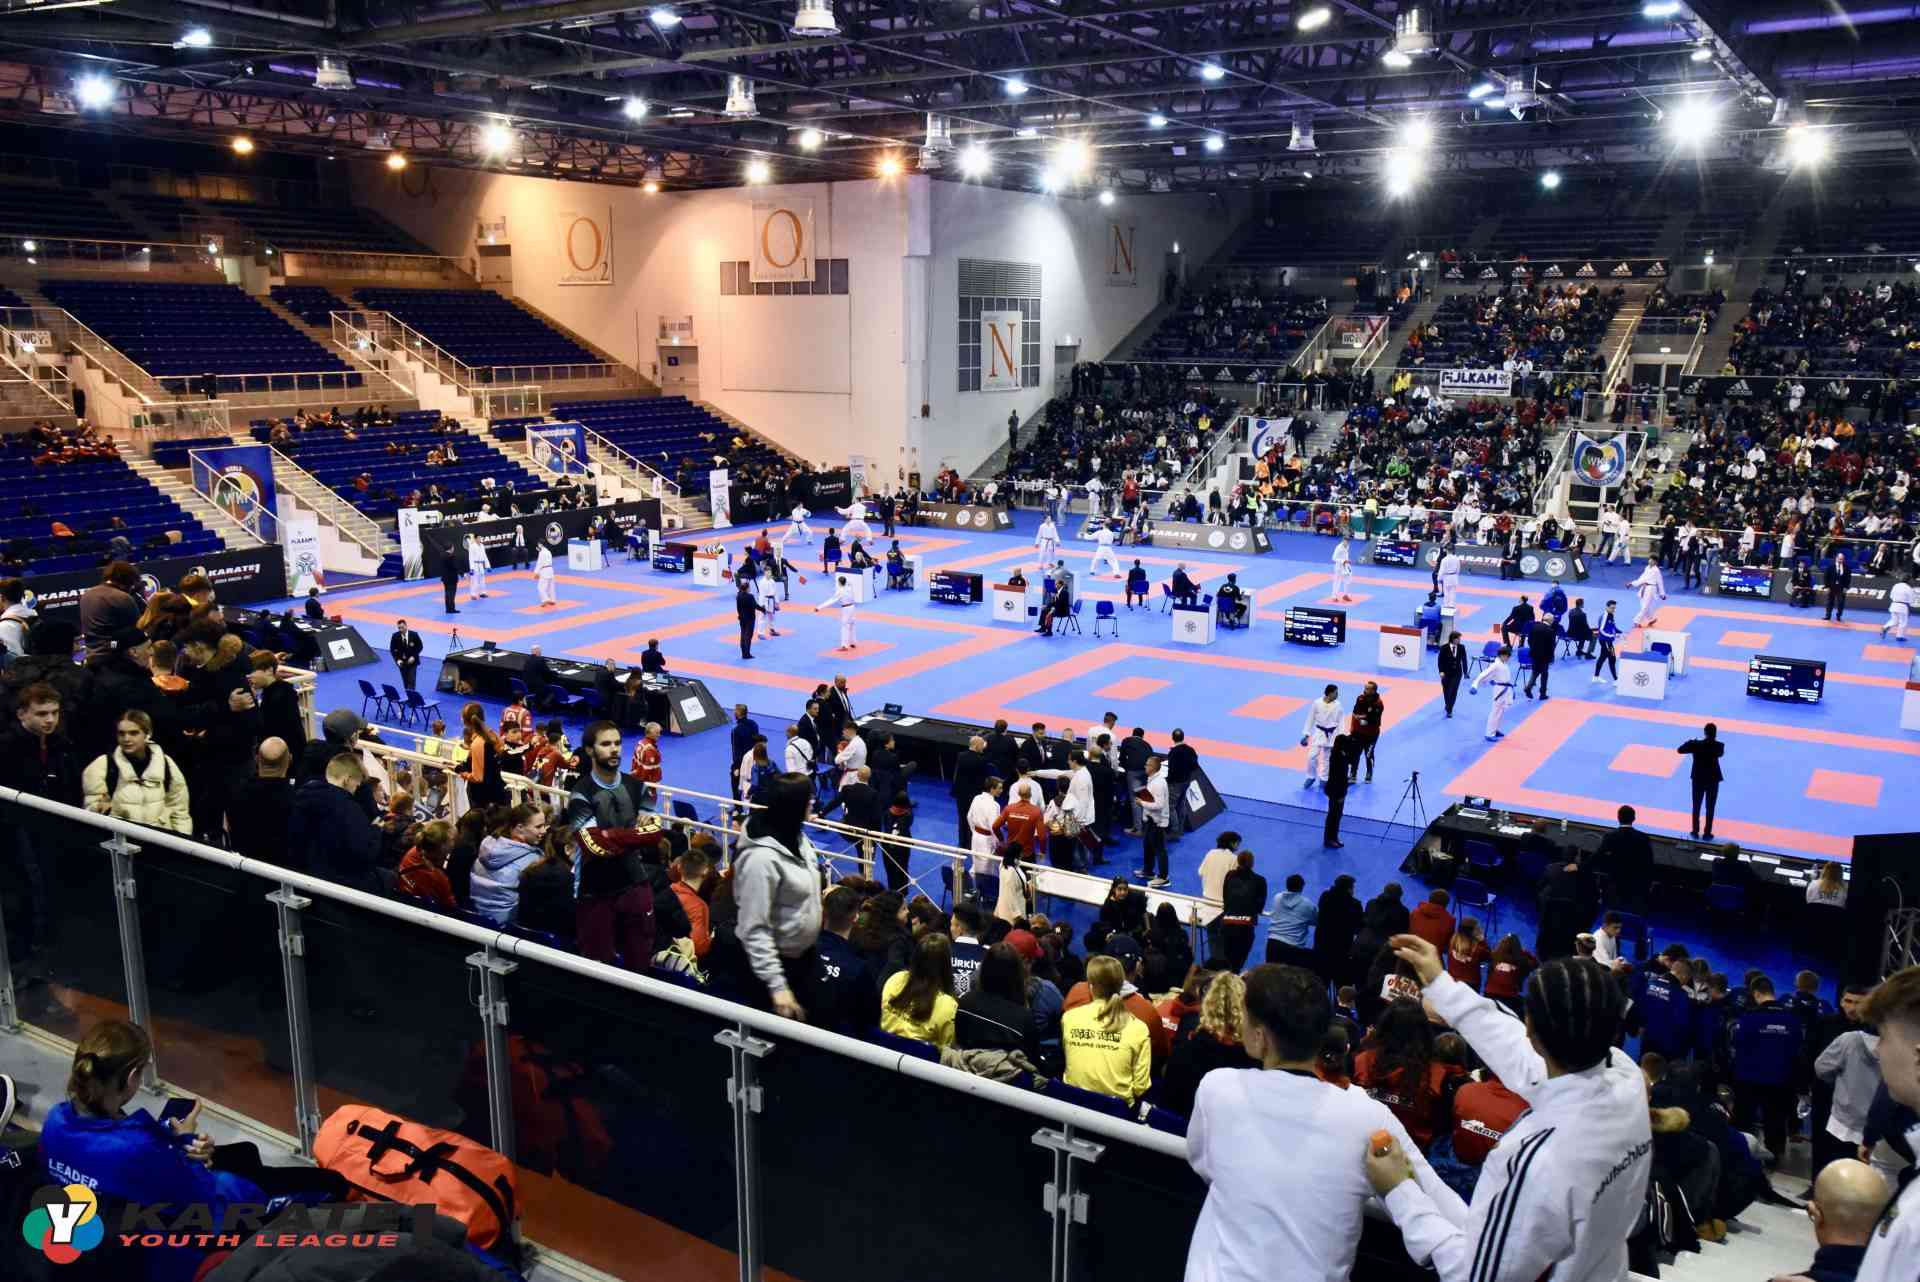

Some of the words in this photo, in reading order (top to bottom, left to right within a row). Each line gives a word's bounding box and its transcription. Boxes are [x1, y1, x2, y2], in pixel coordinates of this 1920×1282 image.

[762, 208, 802, 268] O
[988, 323, 1016, 377] N
[208, 563, 261, 578] KARATE1
[37, 588, 88, 601] KARAT
[951, 956, 981, 969] ÜRKİY
[48, 1158, 99, 1190] LEADER
